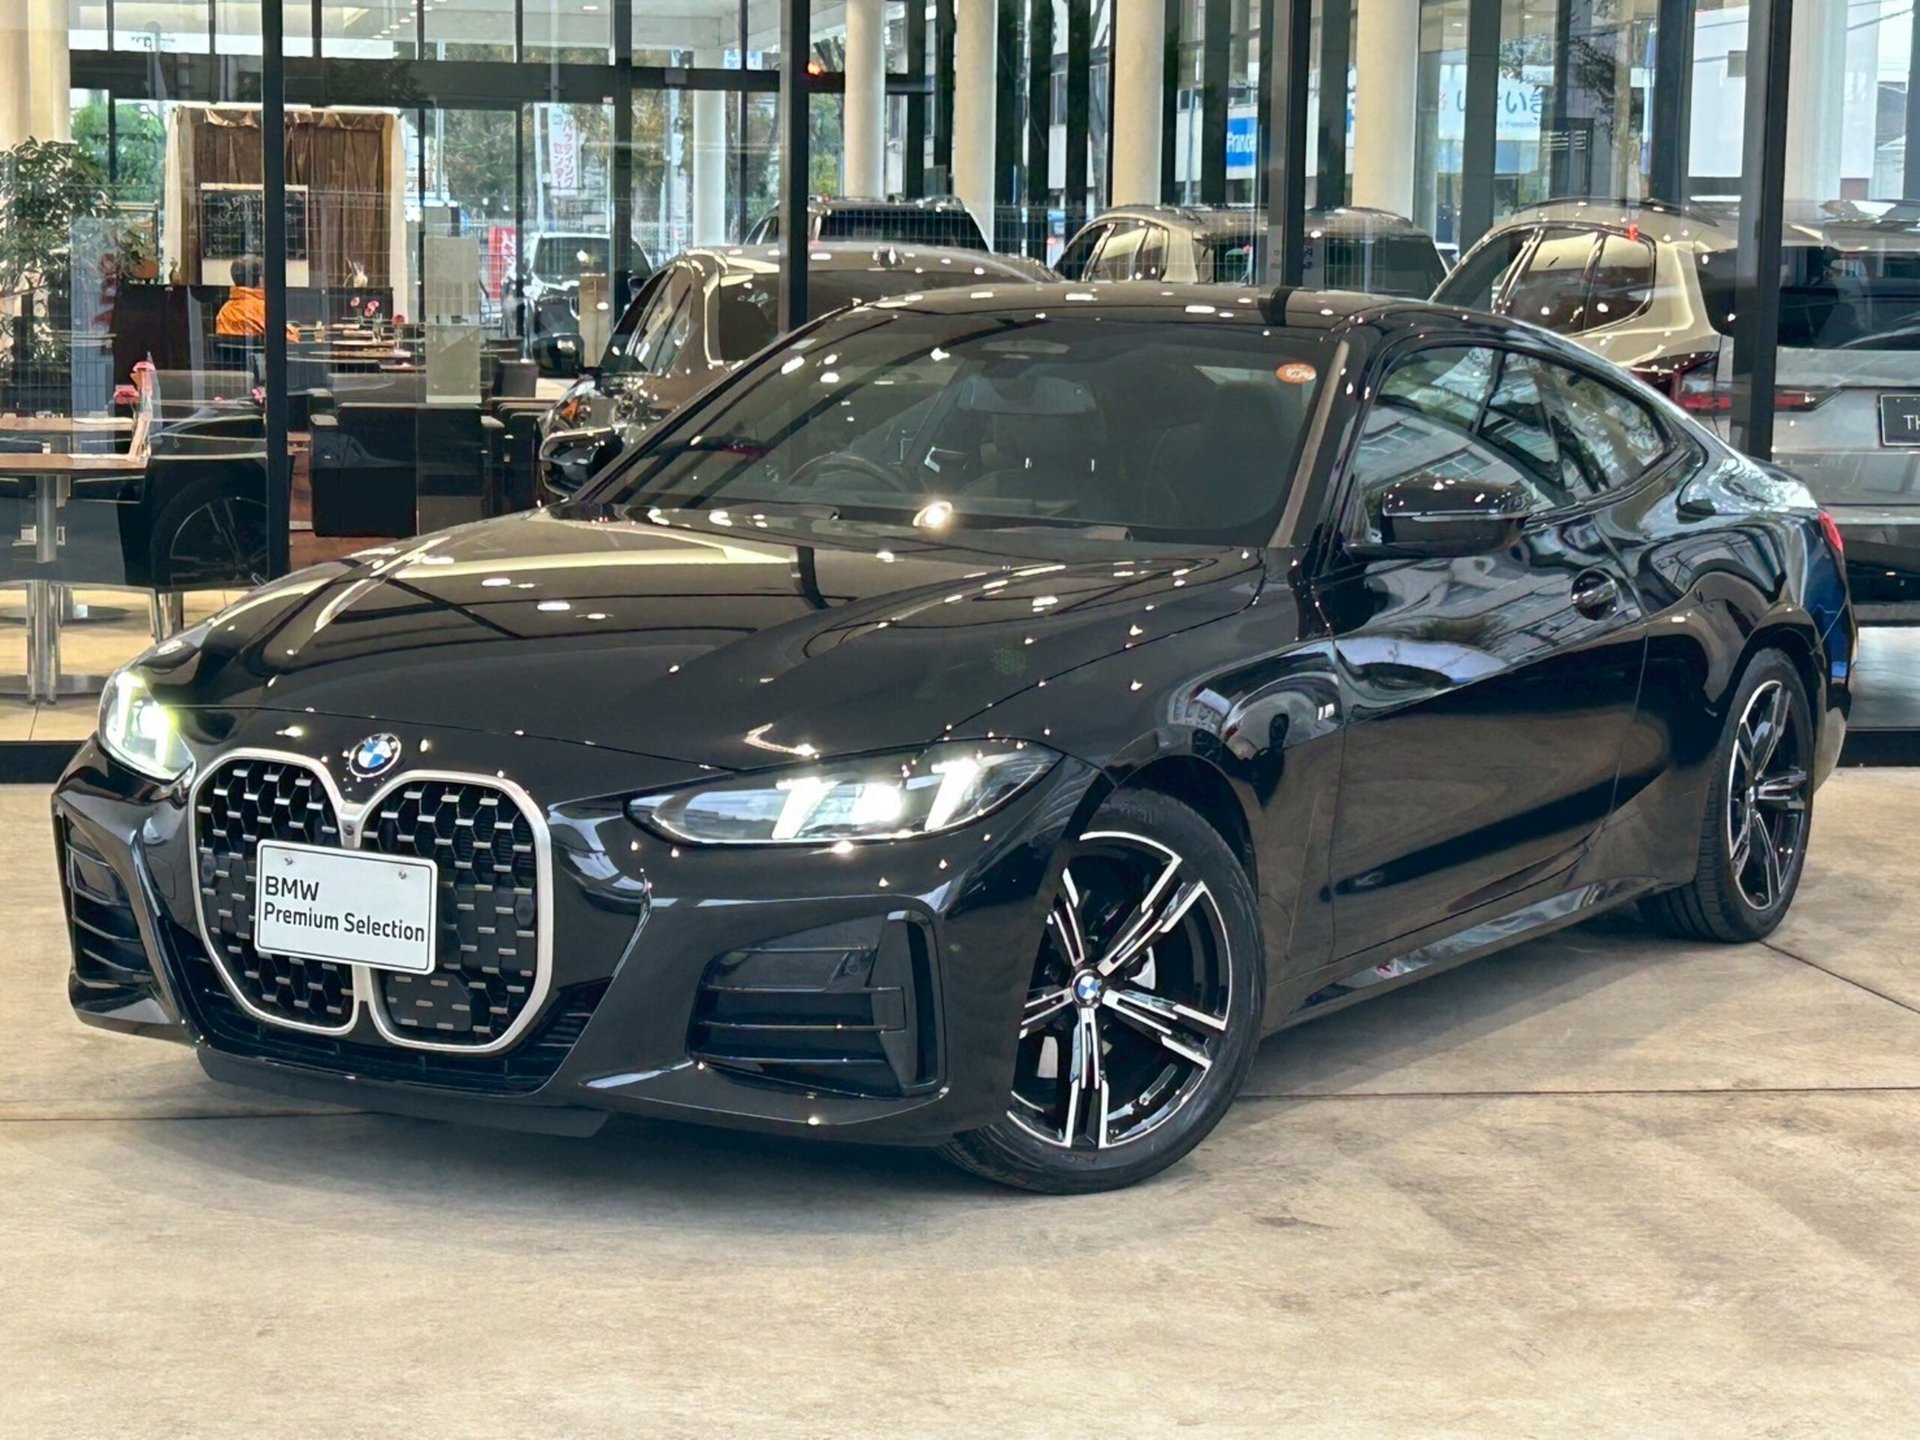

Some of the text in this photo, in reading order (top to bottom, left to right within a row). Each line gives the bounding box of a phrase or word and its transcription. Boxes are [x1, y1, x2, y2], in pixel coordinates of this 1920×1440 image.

[265, 875, 319, 901] BMW
[264, 902, 425, 942] Premium Selection
